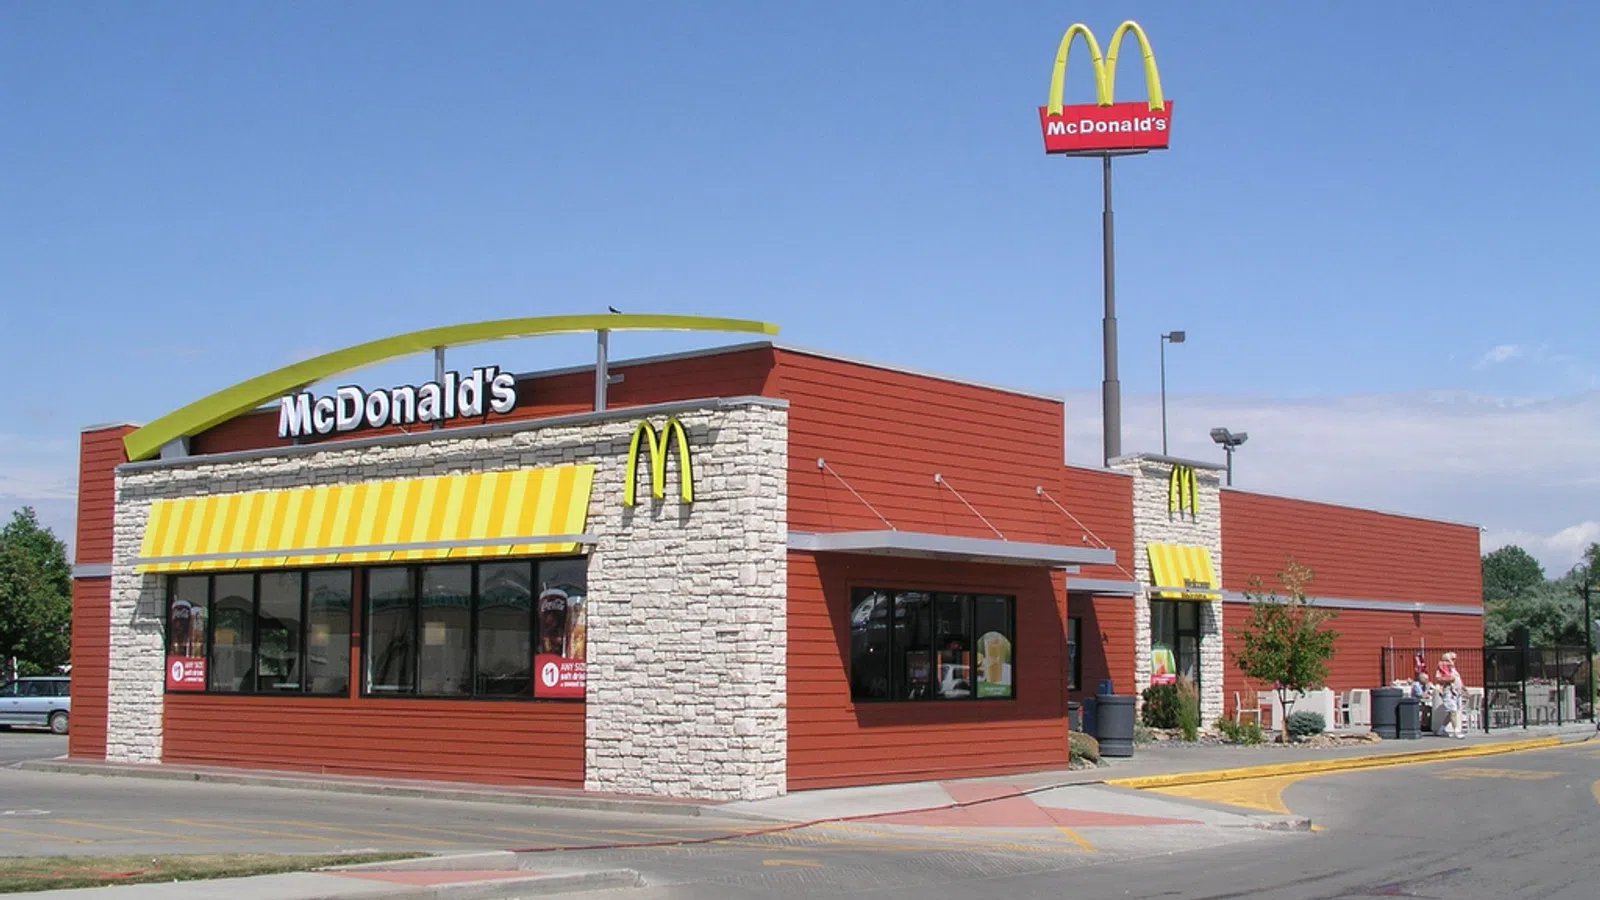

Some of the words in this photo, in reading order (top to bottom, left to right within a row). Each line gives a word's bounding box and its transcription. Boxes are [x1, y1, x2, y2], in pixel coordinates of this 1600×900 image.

[1047, 117, 1166, 135] McDonald's
[278, 365, 517, 438] McDonald's
[545, 668, 555, 682] $1
[574, 663, 587, 671] SIZ
